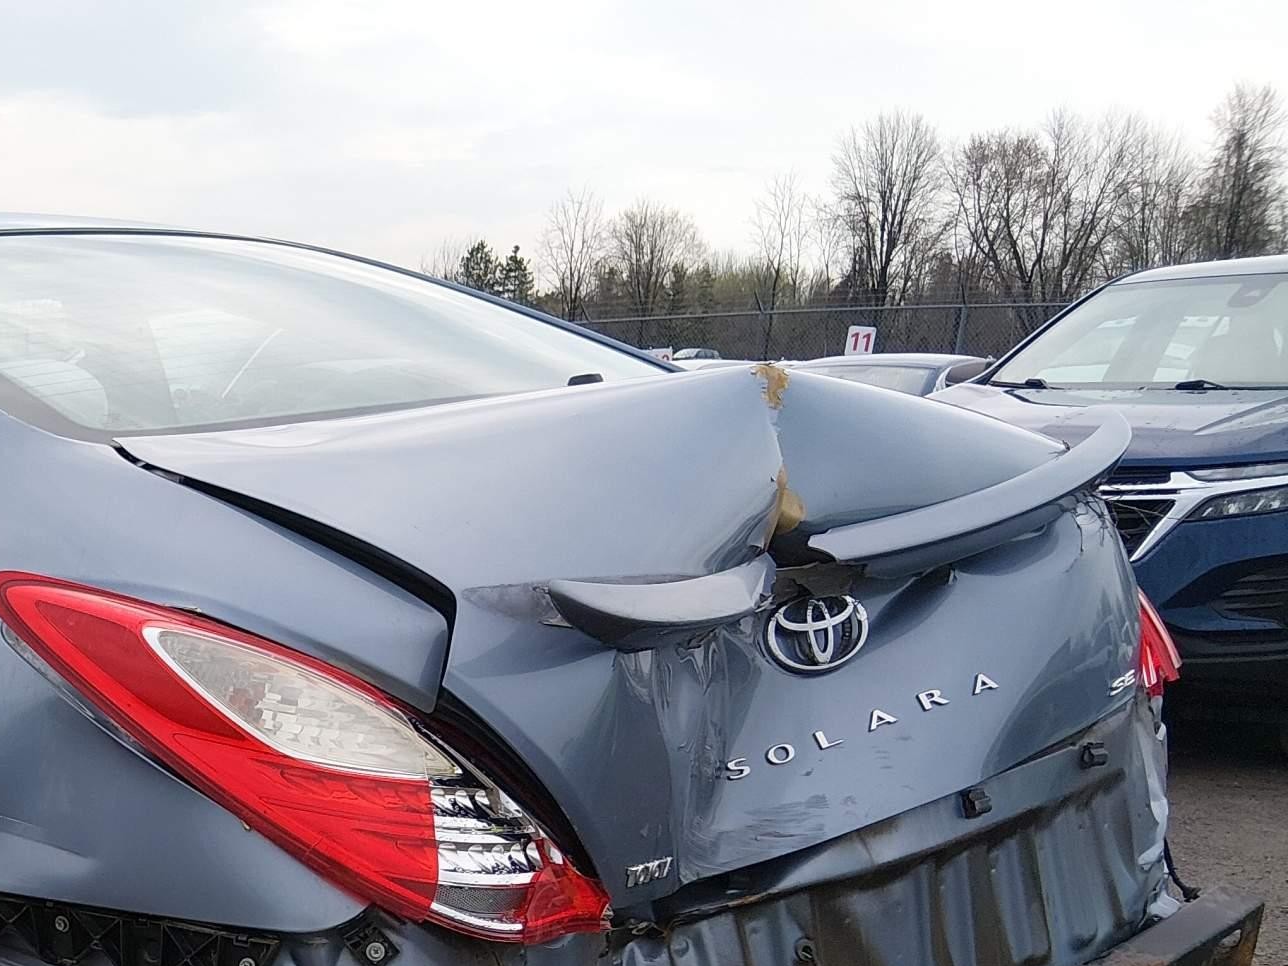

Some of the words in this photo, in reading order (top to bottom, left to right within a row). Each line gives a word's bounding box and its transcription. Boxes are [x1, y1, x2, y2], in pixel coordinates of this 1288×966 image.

[851, 332, 872, 352] 11
[1109, 669, 1135, 697] SE
[726, 672, 999, 780] SOLARA
